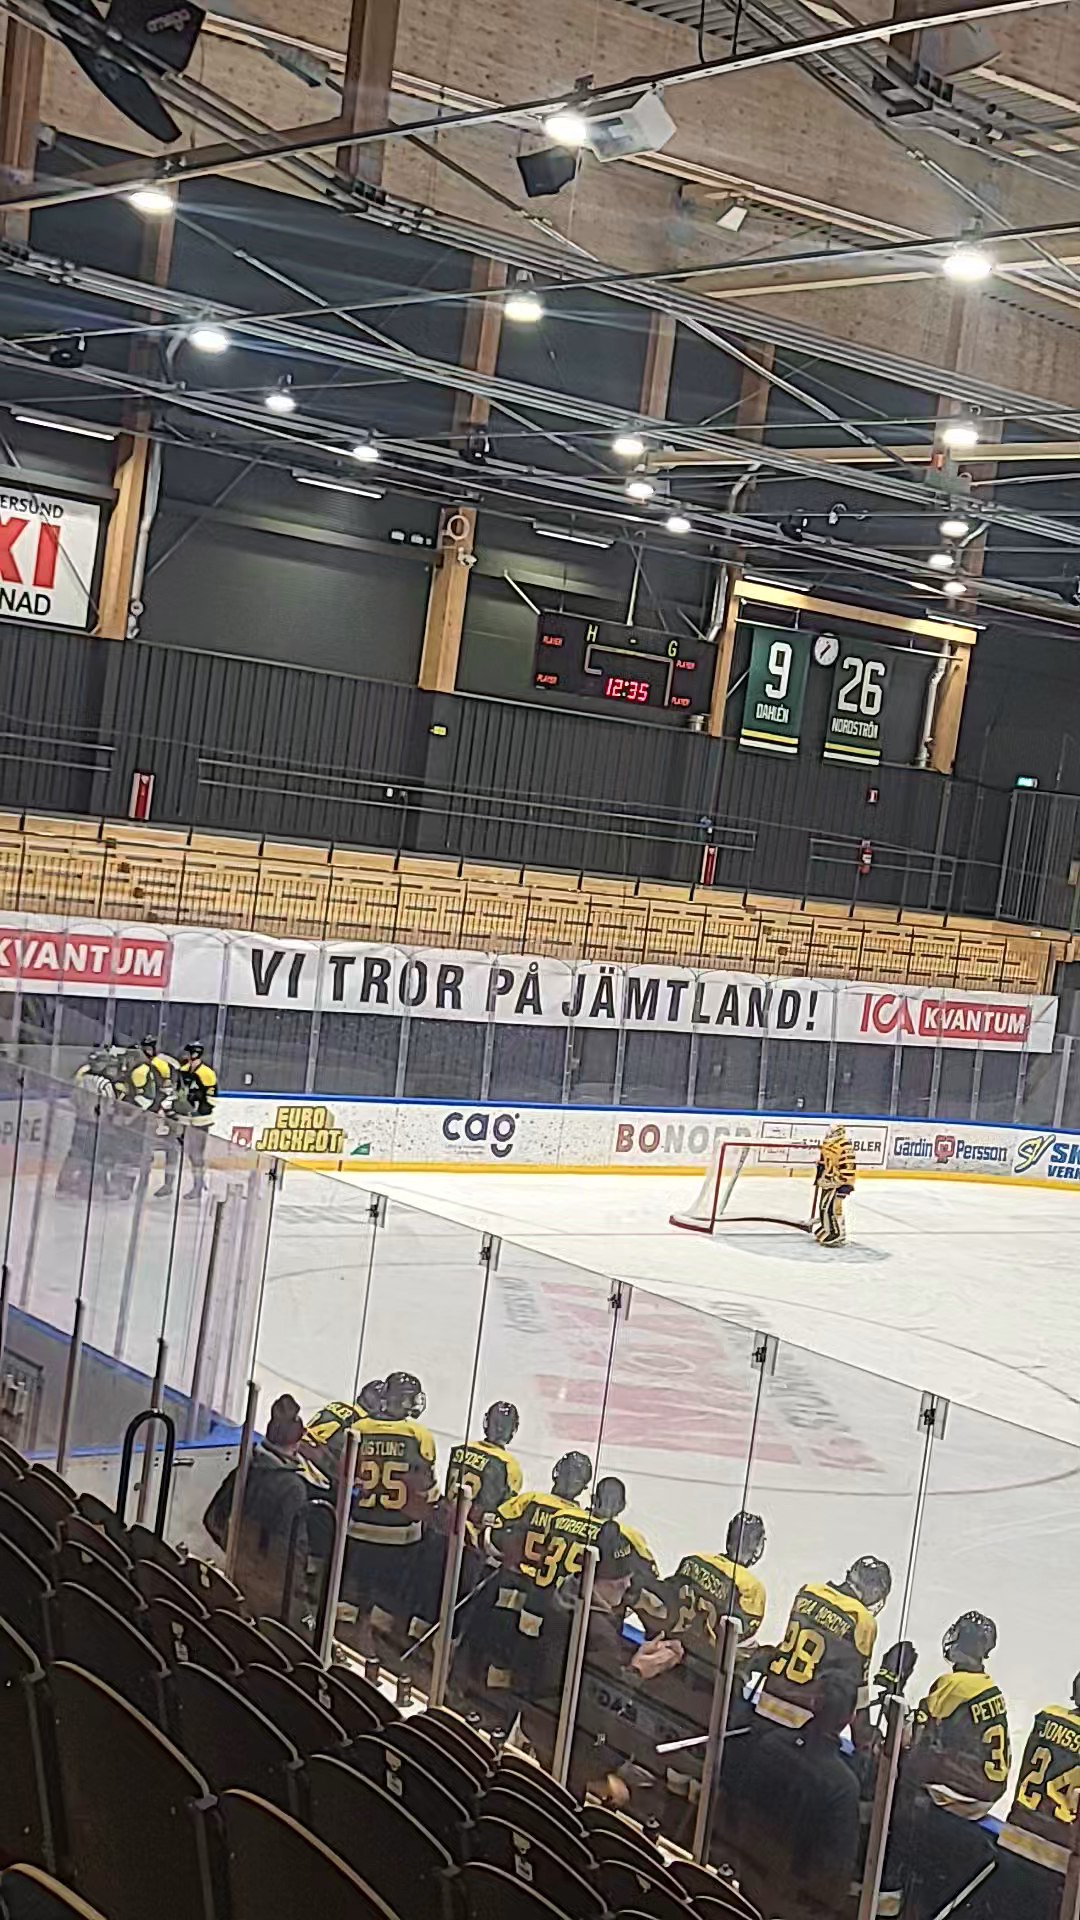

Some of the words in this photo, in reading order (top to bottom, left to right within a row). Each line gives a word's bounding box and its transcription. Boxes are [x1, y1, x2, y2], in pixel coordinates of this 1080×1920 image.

[586, 624, 599, 642] H
[667, 640, 678, 657] G
[765, 641, 792, 699] 9
[837, 656, 886, 716] 26
[606, 678, 649, 701] 12:35
[755, 703, 790, 724] DAHLÉN
[251, 948, 306, 998] VI
[328, 955, 464, 1009] TROR
[485, 961, 543, 1015] PÅ
[561, 966, 818, 1031] JÄMTLAND!
[860, 992, 915, 1034] ICA
[924, 1006, 1026, 1034] KVANTUM
[275, 1105, 328, 1128] EURO
[256, 1127, 344, 1153] JACKPOT
[442, 1111, 520, 1158] cag
[955, 1139, 1007, 1162] Persson
[358, 1460, 410, 1510] 25
[1017, 1746, 1080, 1825] 24
